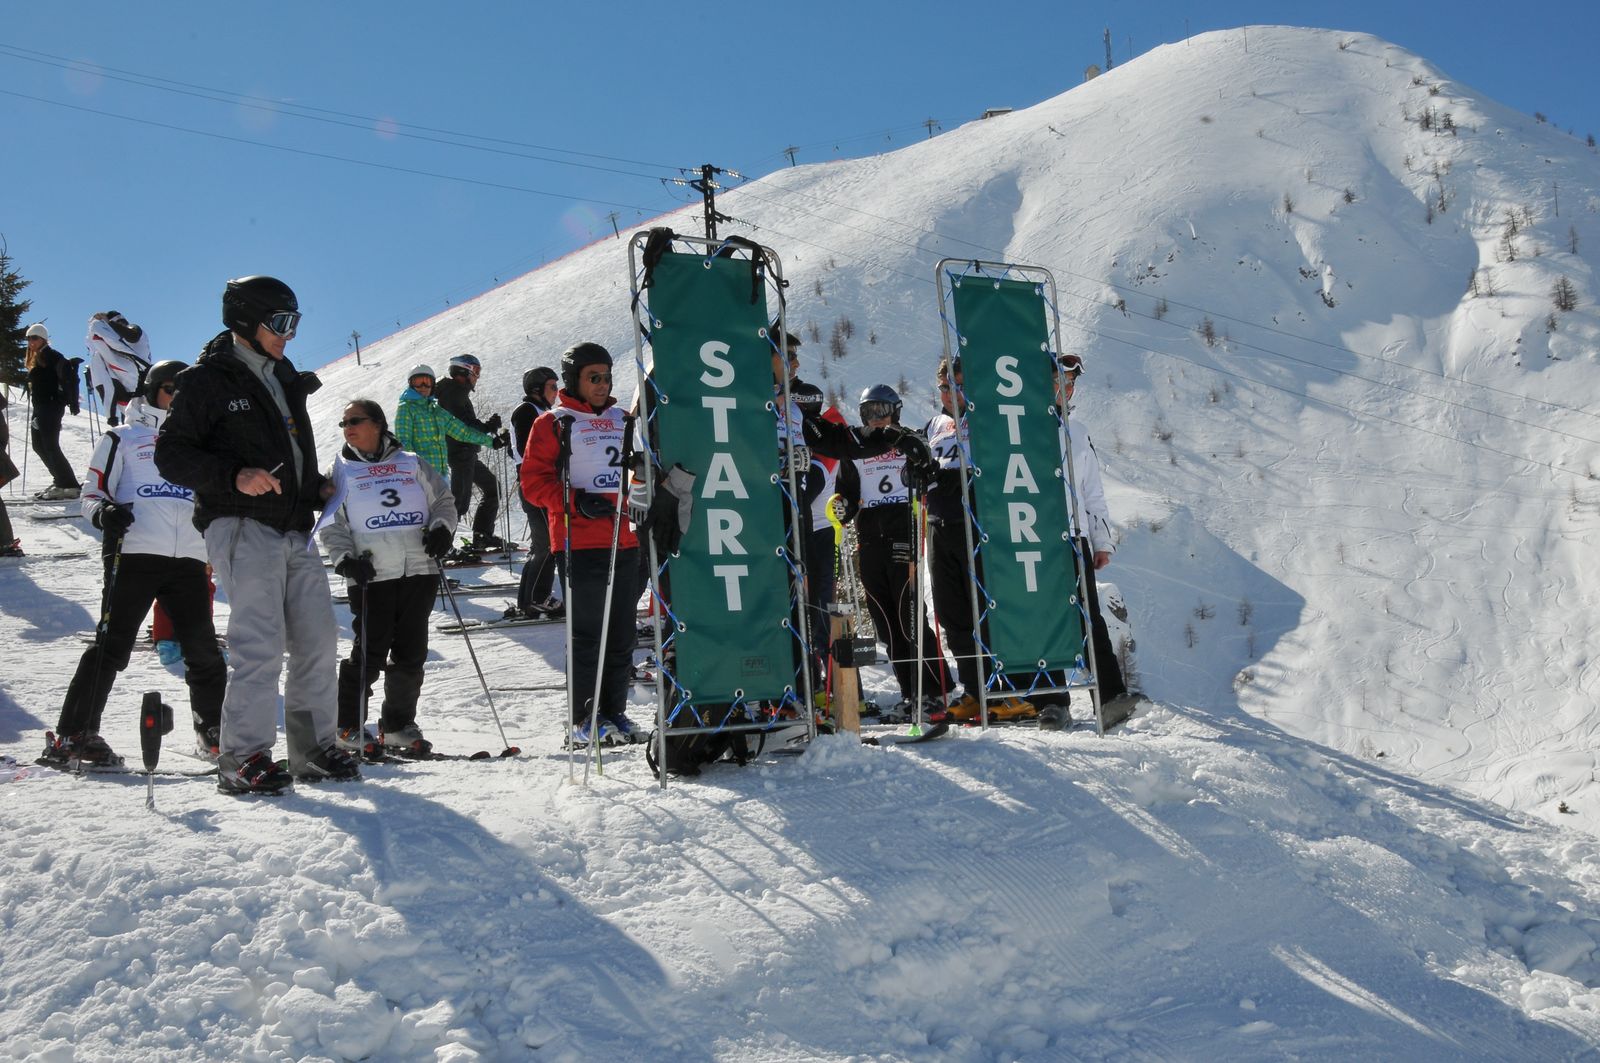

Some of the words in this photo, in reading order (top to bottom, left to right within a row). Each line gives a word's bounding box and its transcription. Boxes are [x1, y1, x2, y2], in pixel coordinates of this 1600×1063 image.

[605, 445, 622, 467] 2
[935, 444, 959, 462] 14
[593, 470, 621, 488] CLA
[699, 340, 750, 611] START
[995, 355, 1042, 592] START
[137, 482, 195, 502] CLAN2
[878, 474, 893, 494] 6
[380, 488, 401, 507] 3
[366, 510, 424, 529] CLAN2
